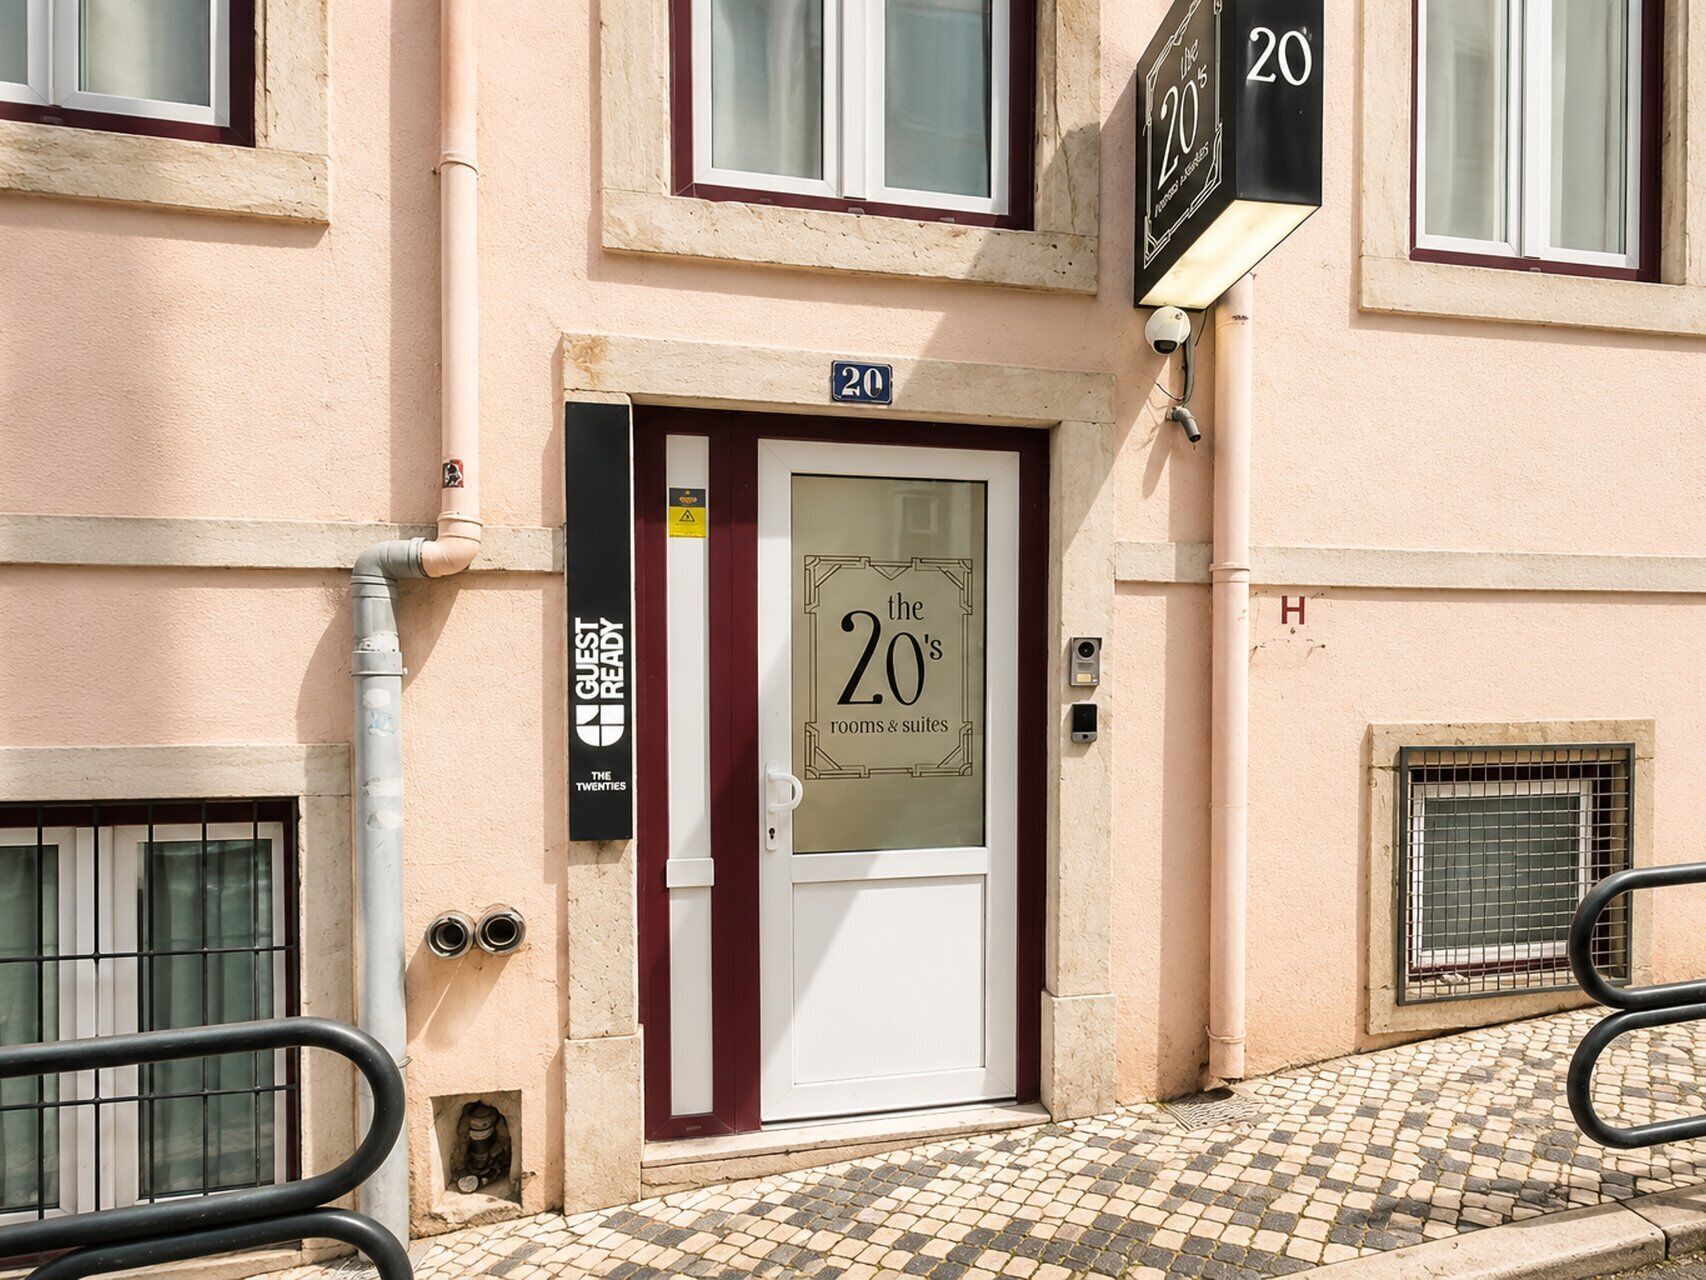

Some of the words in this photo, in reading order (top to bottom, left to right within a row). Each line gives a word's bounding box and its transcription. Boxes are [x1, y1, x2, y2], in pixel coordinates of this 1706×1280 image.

[1246, 26, 1313, 86] 20
[841, 366, 883, 398] 20
[888, 592, 925, 621] the
[1281, 595, 1306, 625] H
[575, 617, 600, 700] GUEST
[600, 617, 624, 699] READY
[836, 610, 944, 706] 20's
[830, 718, 885, 734] rooms
[887, 720, 899, 733] &
[902, 716, 949, 733] suites
[576, 781, 627, 792] TWENTIES
[591, 771, 612, 781] THE
